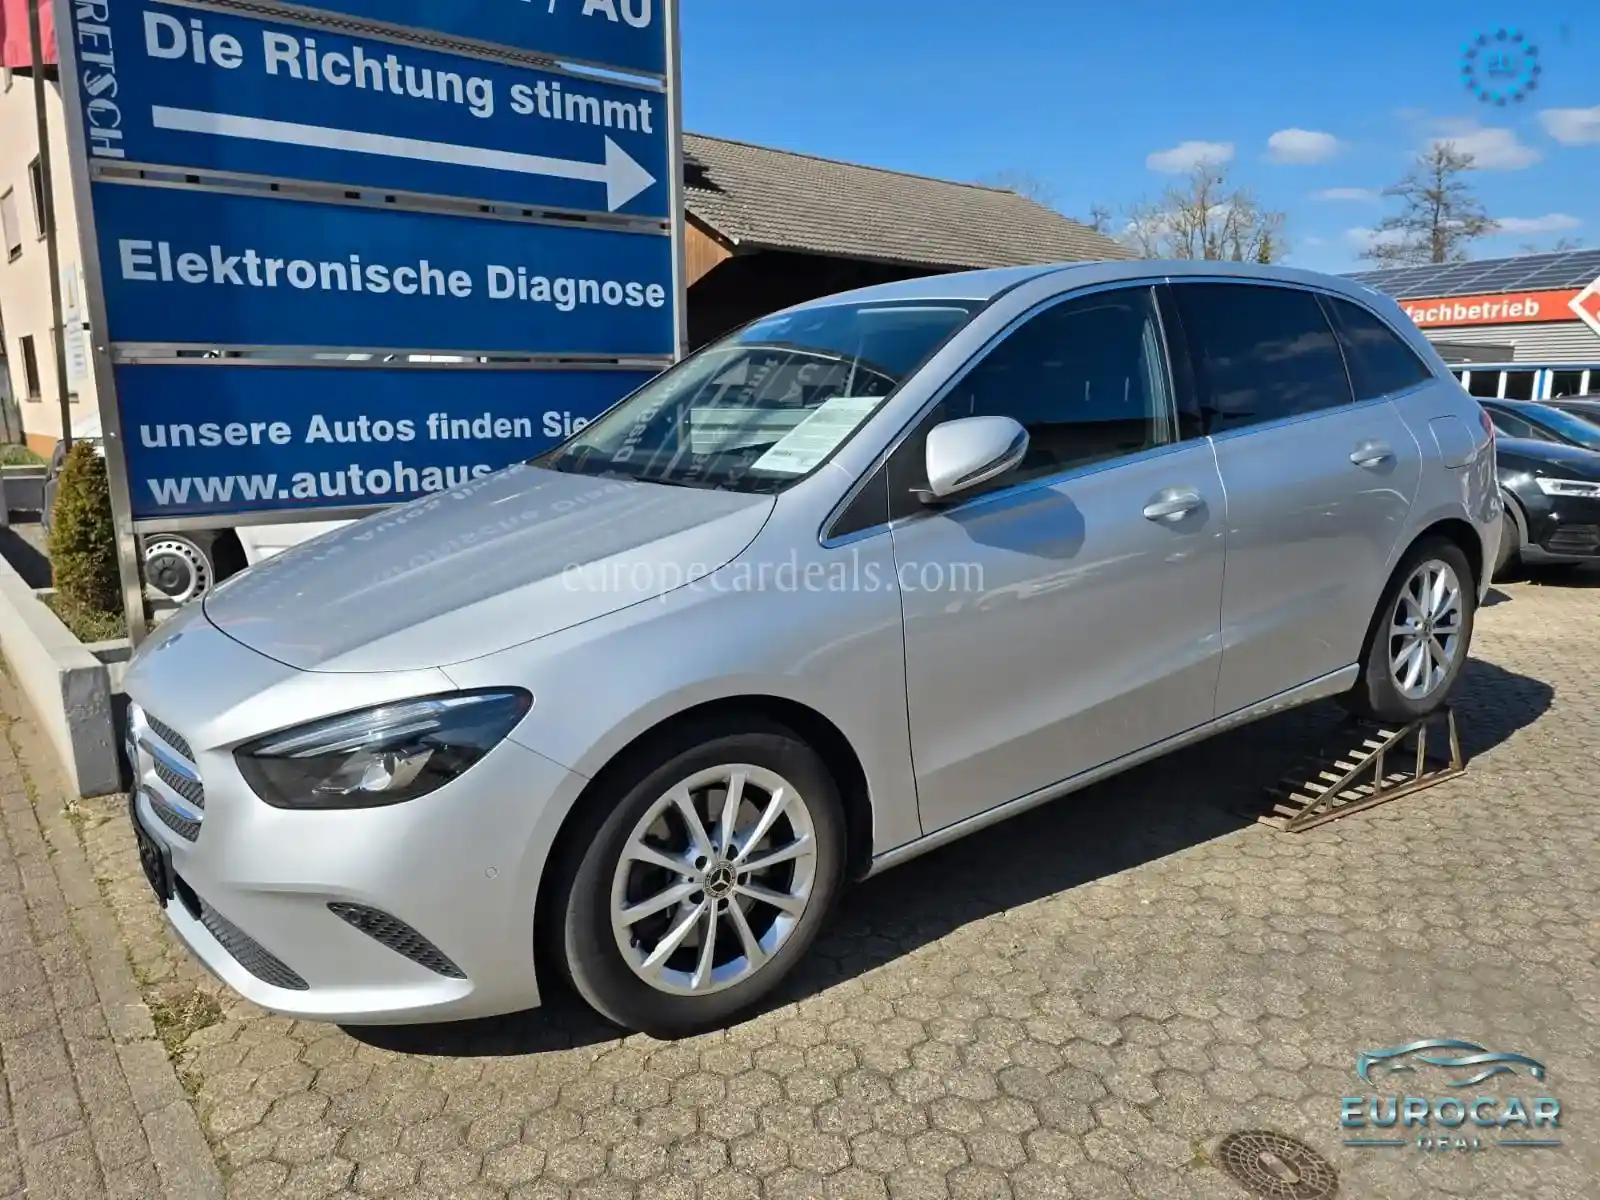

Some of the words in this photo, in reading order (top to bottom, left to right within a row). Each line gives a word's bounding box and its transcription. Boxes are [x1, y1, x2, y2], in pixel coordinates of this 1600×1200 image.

[143, 11, 243, 69] Die
[262, 30, 494, 118] Richtung
[510, 80, 653, 134] stimmt
[119, 239, 474, 298] Elektronische
[487, 264, 665, 312] Diagnose
[140, 421, 292, 448] unsere
[305, 414, 416, 444] Autos
[426, 412, 532, 440] finden
[542, 411, 589, 437] Sie
